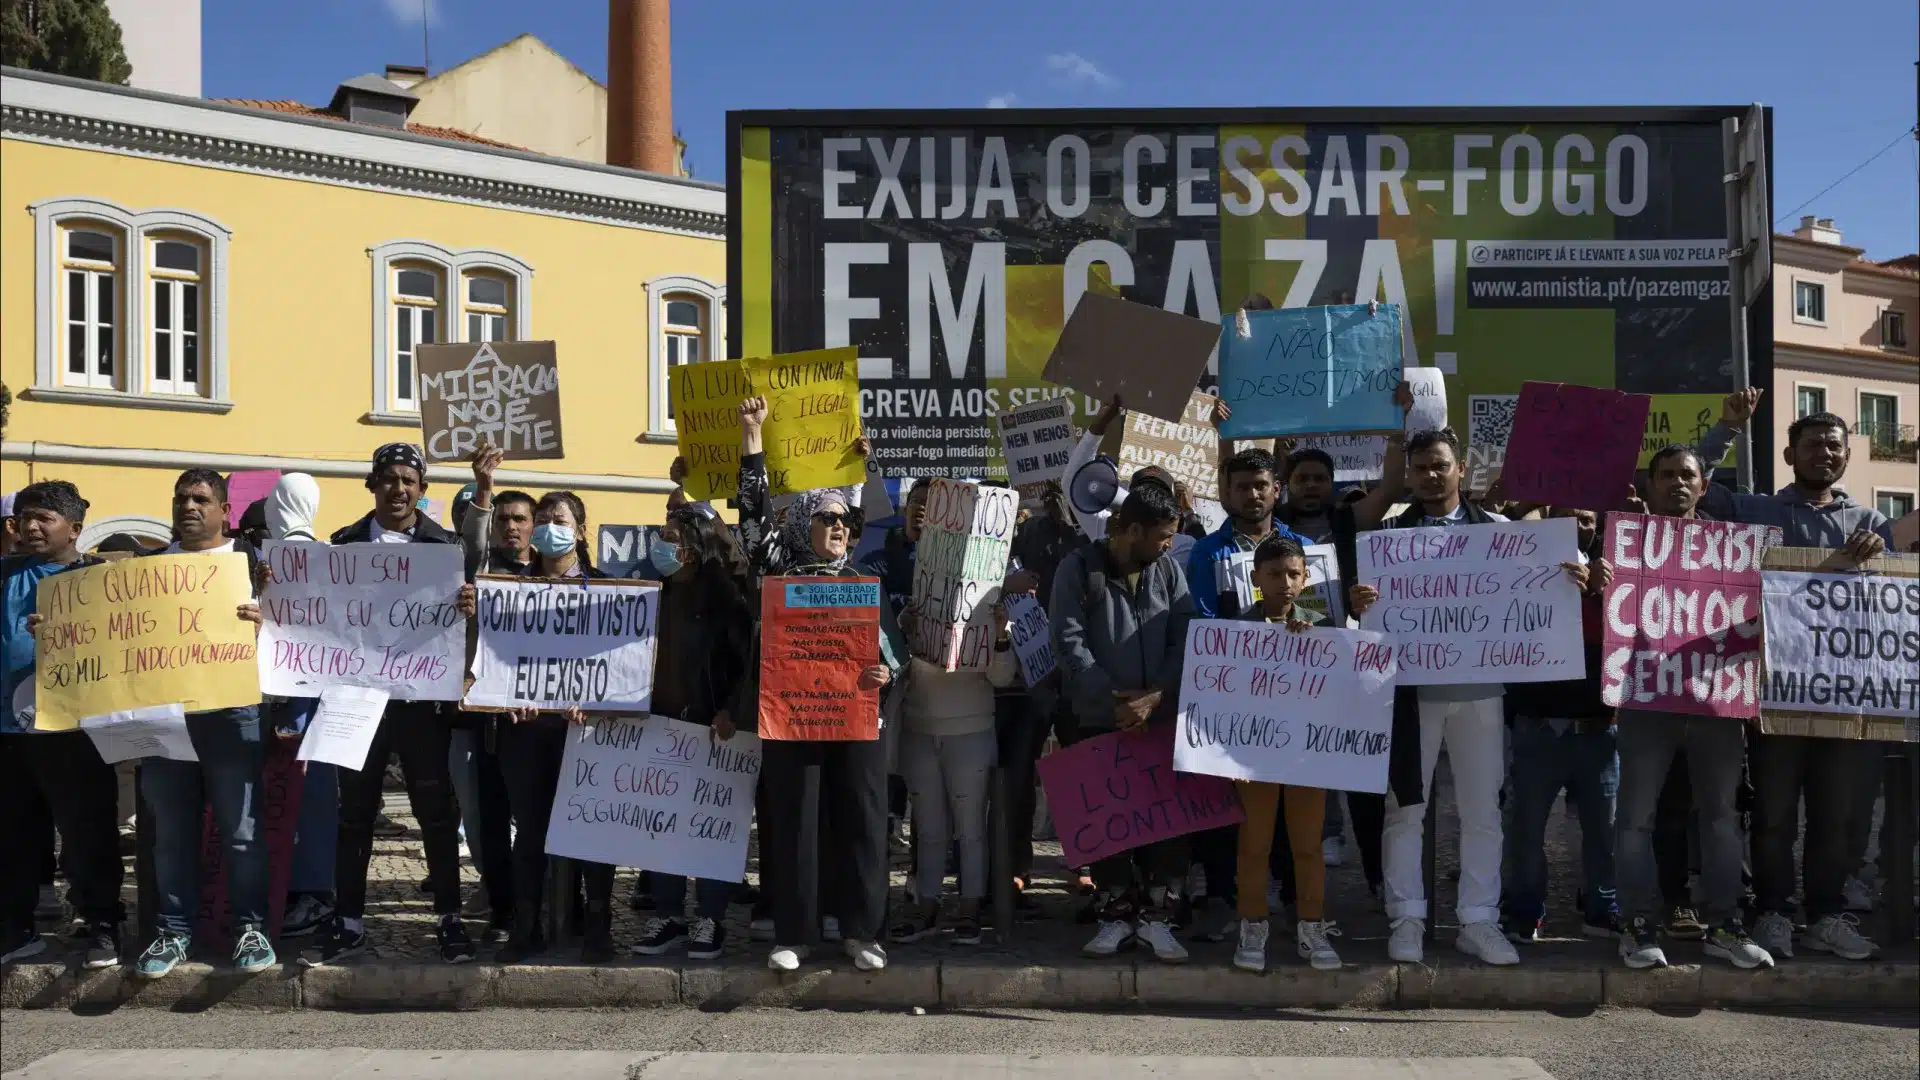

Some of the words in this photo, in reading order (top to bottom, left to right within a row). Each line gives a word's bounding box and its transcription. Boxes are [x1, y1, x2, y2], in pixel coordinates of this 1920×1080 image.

[822, 136, 1019, 219] EXIJA
[1046, 134, 1091, 218] O
[1122, 132, 1650, 218] CESSAR-FOGO
[1494, 249, 1552, 261] PARTICIPE
[1555, 246, 1568, 261] JÁ
[1570, 249, 1577, 261] E
[1579, 248, 1626, 261] LEVANTE
[1628, 248, 1636, 261] A
[1639, 248, 1660, 260] SUA
[1663, 248, 1685, 260] VOZ
[1687, 248, 1715, 260] PELA
[824, 241, 1006, 380] EM
[462, 342, 508, 373] A
[1266, 327, 1335, 361] NÃO
[681, 368, 695, 402] A
[705, 366, 756, 399] LUTA
[768, 360, 845, 390] CONTINUA
[1236, 367, 1400, 402] DESISTIMOS
[794, 392, 849, 420] ILEGAL
[949, 388, 1001, 418] AOS
[428, 420, 558, 459] CRIME
[876, 446, 943, 460] cessar-fogo
[946, 445, 995, 458] imediato
[892, 425, 943, 439] violência
[945, 427, 994, 444] persiste,
[1006, 431, 1030, 450] NEM
[1034, 423, 1070, 444] MENOS
[1180, 444, 1207, 462] DA
[887, 466, 907, 478] aos
[910, 465, 949, 478] nossos
[1016, 457, 1040, 473] NEM
[1044, 449, 1070, 468] MAIS
[973, 488, 1012, 538] NÓS
[1368, 534, 1469, 568] PRECISAM
[1486, 531, 1537, 560] MAIS
[1613, 519, 1677, 570] EU
[269, 545, 308, 584] COM
[329, 551, 357, 585] OU
[371, 553, 410, 584] SEM
[49, 571, 89, 620] ATÉ
[808, 585, 877, 593] SOLIDARIEDADE
[809, 594, 877, 604] IMIGRANTE
[1372, 571, 1500, 600] IMIGRANTES
[1806, 578, 1919, 616] SOMOS
[41, 621, 97, 654] SOMOS
[108, 610, 157, 641] MAIS
[178, 606, 205, 636] DE
[269, 597, 327, 627] VISTO
[347, 602, 372, 627] EU
[389, 599, 457, 630] EXISTO
[481, 588, 519, 632] COM
[523, 591, 550, 634] OU
[553, 592, 591, 635] SEM
[597, 593, 650, 645] VISTO,
[1383, 604, 1489, 633] ESTAMOS
[1503, 598, 1553, 633] AQUI
[273, 640, 364, 677] DIREITOS
[378, 645, 448, 680] IGUAIS
[1193, 626, 1337, 669] CONTRIBUIMOS
[1354, 640, 1392, 672] PARA
[1808, 626, 1919, 663] TODOS
[75, 655, 108, 685] MIL
[120, 642, 256, 675] INDOCUMENTADOS
[514, 656, 540, 700] EU
[544, 657, 608, 702] EXISTO
[1194, 664, 1236, 694] ESTE
[1602, 646, 1683, 706] SEM
[1185, 701, 1291, 750] QUEREMOS
[575, 757, 600, 788] DE
[614, 763, 679, 795] EUROS
[693, 777, 733, 808] PARA
[689, 812, 736, 843] SOCIAL
